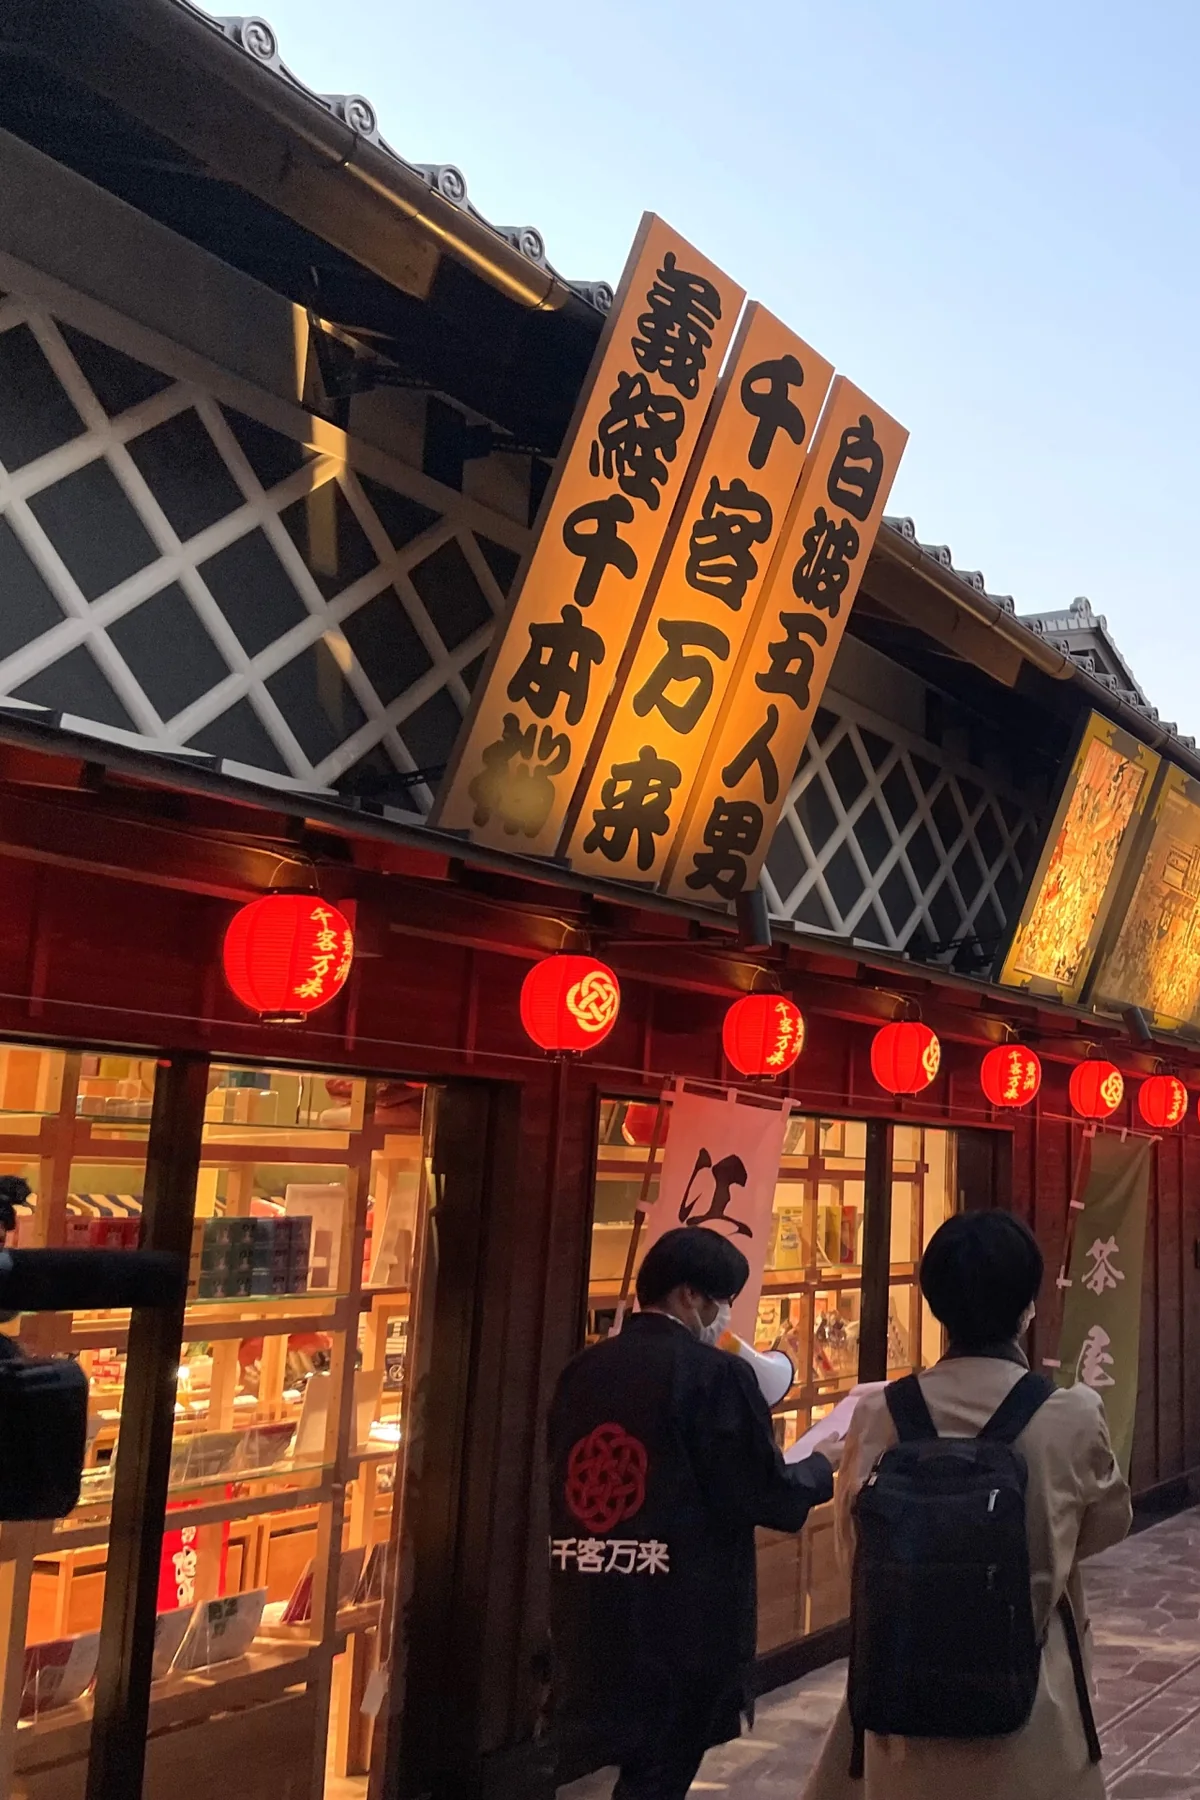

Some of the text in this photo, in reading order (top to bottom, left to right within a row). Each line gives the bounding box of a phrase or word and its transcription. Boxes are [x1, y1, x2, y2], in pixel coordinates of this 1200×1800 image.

[582, 354, 806, 871] 千客万来
[296, 906, 339, 998] 千客万来
[765, 1002, 794, 1066] 千客万来
[551, 1537, 670, 1575] 千客万来
